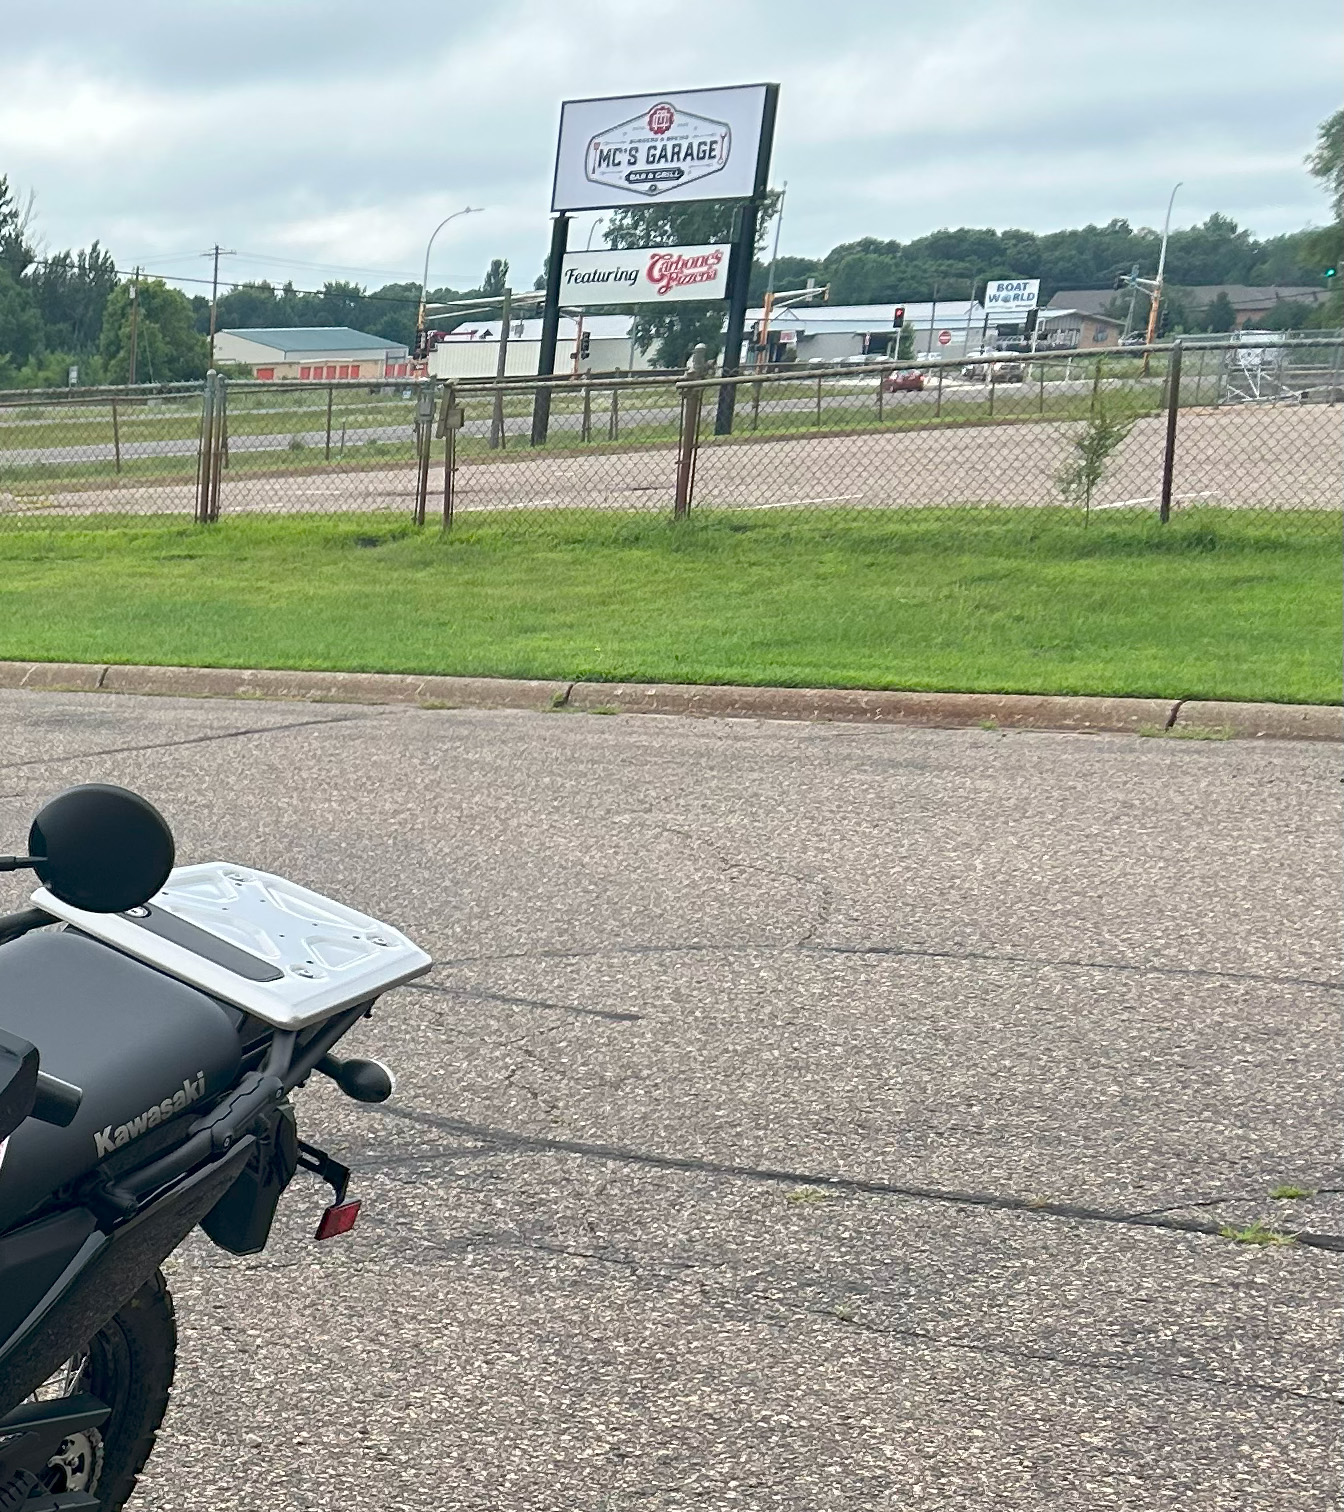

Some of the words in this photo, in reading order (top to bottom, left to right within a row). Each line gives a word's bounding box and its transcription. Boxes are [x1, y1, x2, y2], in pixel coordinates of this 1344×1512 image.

[597, 146, 639, 168] MC'S
[646, 139, 719, 164] GARAGE
[629, 173, 647, 181] BAR
[655, 170, 680, 179] GRILL
[564, 266, 640, 287] Featuring
[996, 282, 1029, 292] BOAT
[93, 1070, 205, 1158] Kawasaki
